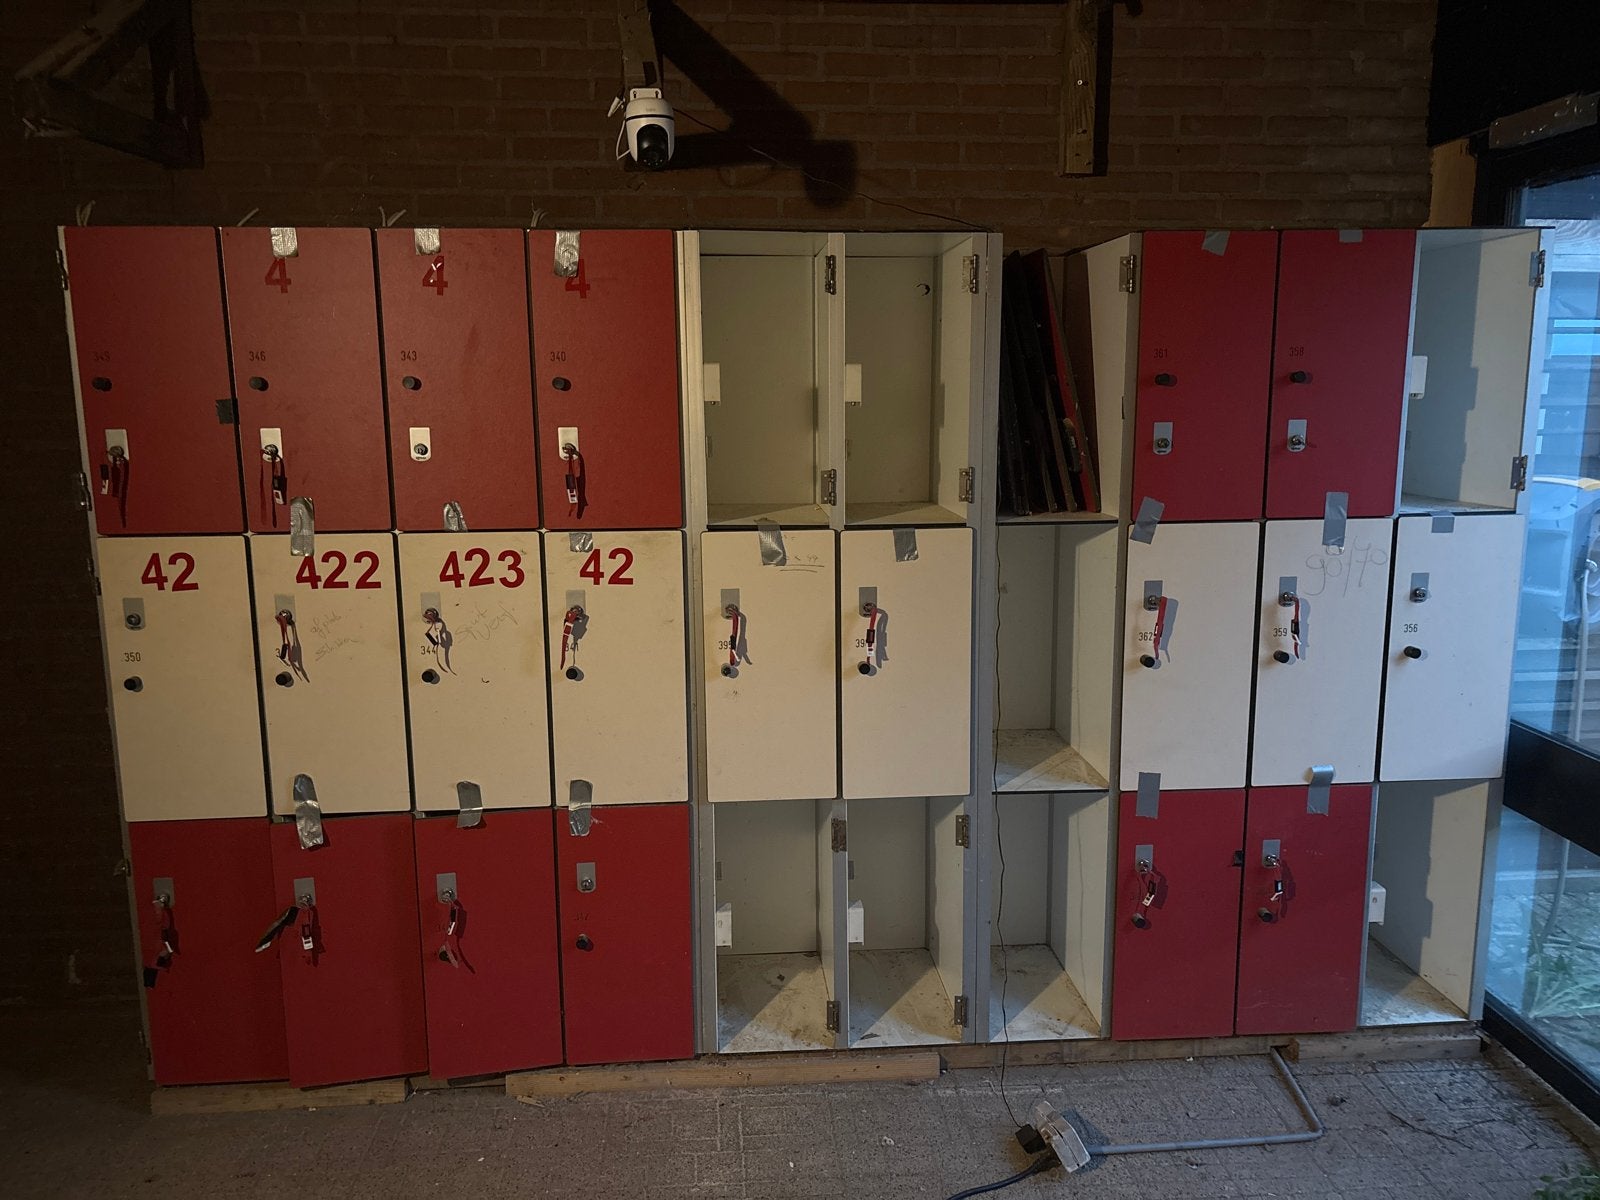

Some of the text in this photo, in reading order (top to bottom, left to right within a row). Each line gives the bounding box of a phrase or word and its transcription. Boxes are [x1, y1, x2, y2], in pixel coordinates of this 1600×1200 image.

[265, 258, 292, 293] 4
[422, 255, 449, 296] 4
[565, 258, 591, 299] 4
[249, 351, 266, 362] 346
[400, 351, 417, 362] 343
[550, 351, 567, 362] 340
[296, 550, 382, 590] 422
[439, 548, 525, 588] 423
[580, 547, 634, 585] 42
[141, 552, 199, 592] 42
[1273, 627, 1288, 637] 359
[1403, 623, 1418, 633] 356
[1138, 632, 1153, 642] 362
[855, 638, 867, 648] 39
[420, 645, 437, 655] 344
[124, 652, 141, 662] 350
